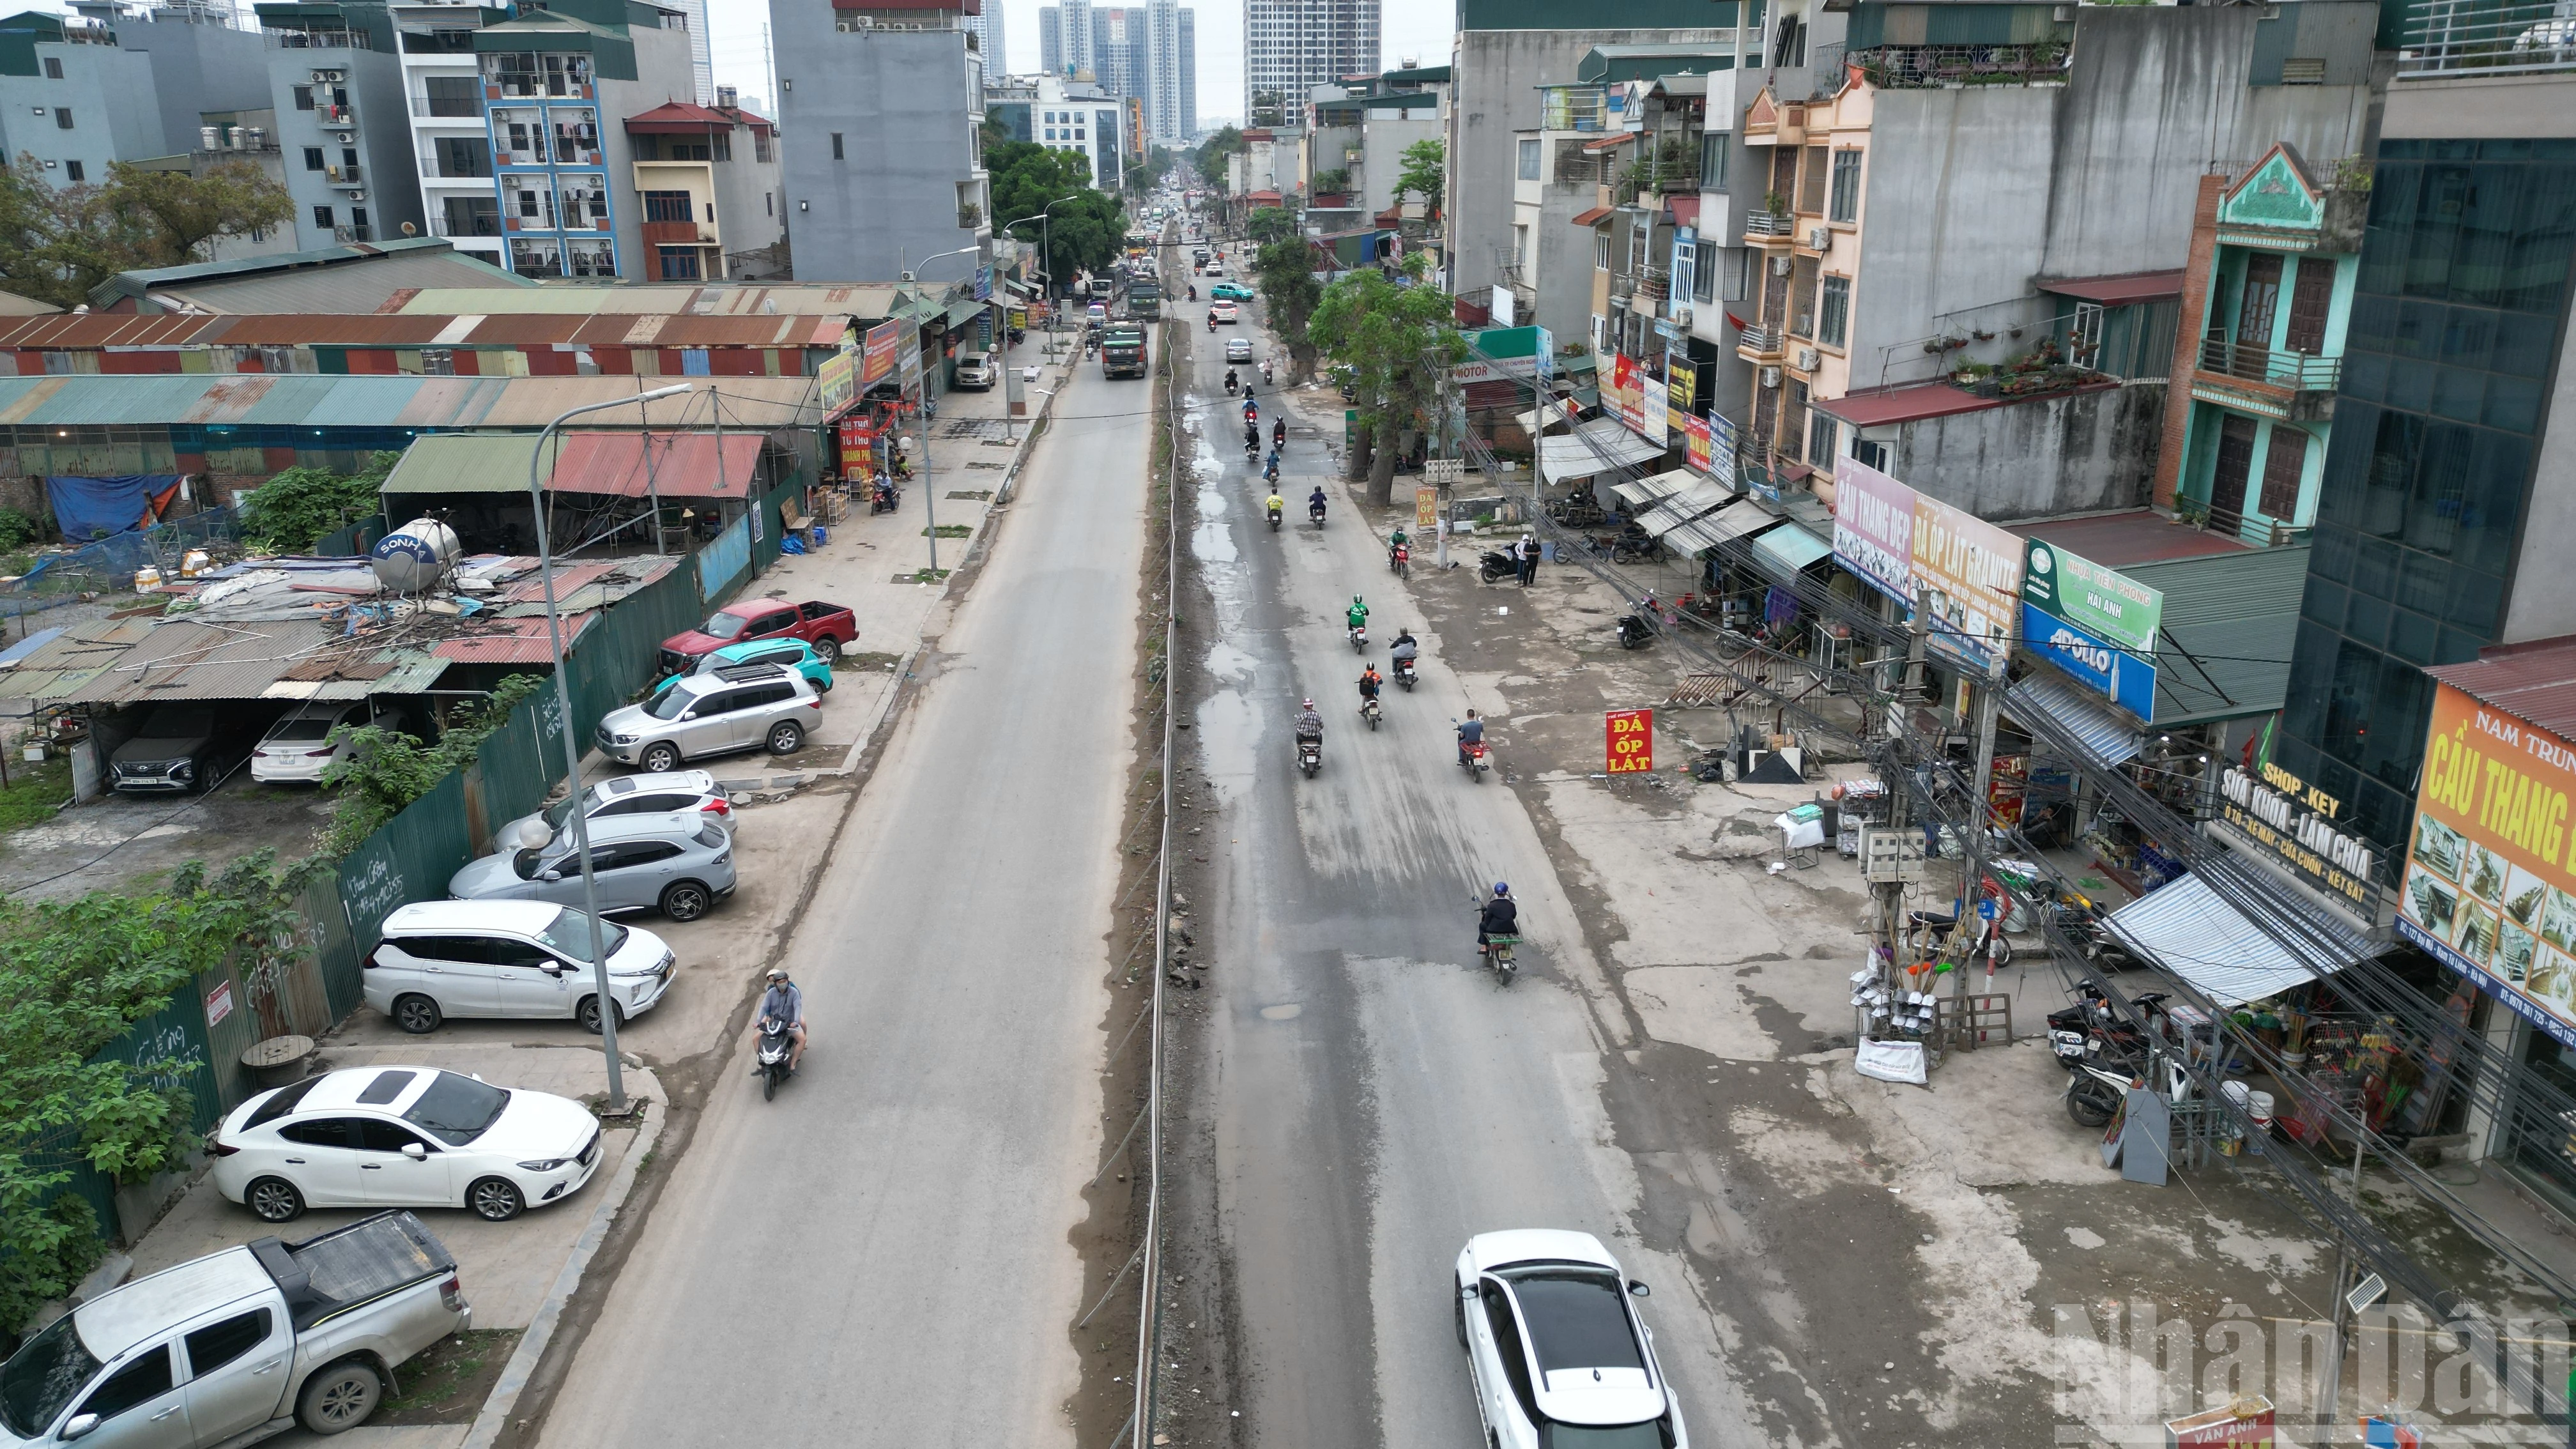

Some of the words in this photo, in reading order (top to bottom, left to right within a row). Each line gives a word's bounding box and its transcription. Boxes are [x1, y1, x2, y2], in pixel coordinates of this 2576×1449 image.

[1858, 489, 1889, 543] THANG
[1889, 506, 1910, 558] ĐẸP
[1913, 510, 1928, 560] ĐÁ
[1929, 514, 1944, 567] ỐP
[1944, 526, 1967, 579] LÁT
[1966, 541, 2018, 607] GRANITE
[2066, 558, 2091, 581] NHỰA
[2117, 580, 2151, 606] PHONG
[2087, 589, 2102, 610] HẢI
[2103, 598, 2122, 620] ANH
[2048, 628, 2110, 671] APOLLO
[1613, 714, 1645, 733] ĐÁ
[1615, 734, 1643, 753] ỐP
[2475, 710, 2519, 747] NAM
[1609, 754, 1650, 772] LÁT
[2221, 765, 2251, 808] SỬA
[2251, 785, 2292, 832] KHÓA
[2264, 762, 2301, 795] SHOP
[2308, 786, 2340, 818] KEY
[2428, 719, 2481, 816] CẦU
[2480, 758, 2568, 866] THANG
[2225, 801, 2231, 818] Ô
[2232, 808, 2242, 825] TÔ
[2247, 819, 2258, 836] XE
[2258, 825, 2276, 847] MÁY
[2280, 839, 2297, 861] CỬA
[2409, 927, 2418, 940] 127
[2436, 946, 2448, 962] Nam
[2509, 994, 2523, 1011] 0978
[2522, 1002, 2533, 1018] 361
[2533, 1009, 2545, 1025] 725
[2563, 1029, 2575, 1046] 132
[2227, 1418, 2257, 1437] ANH
